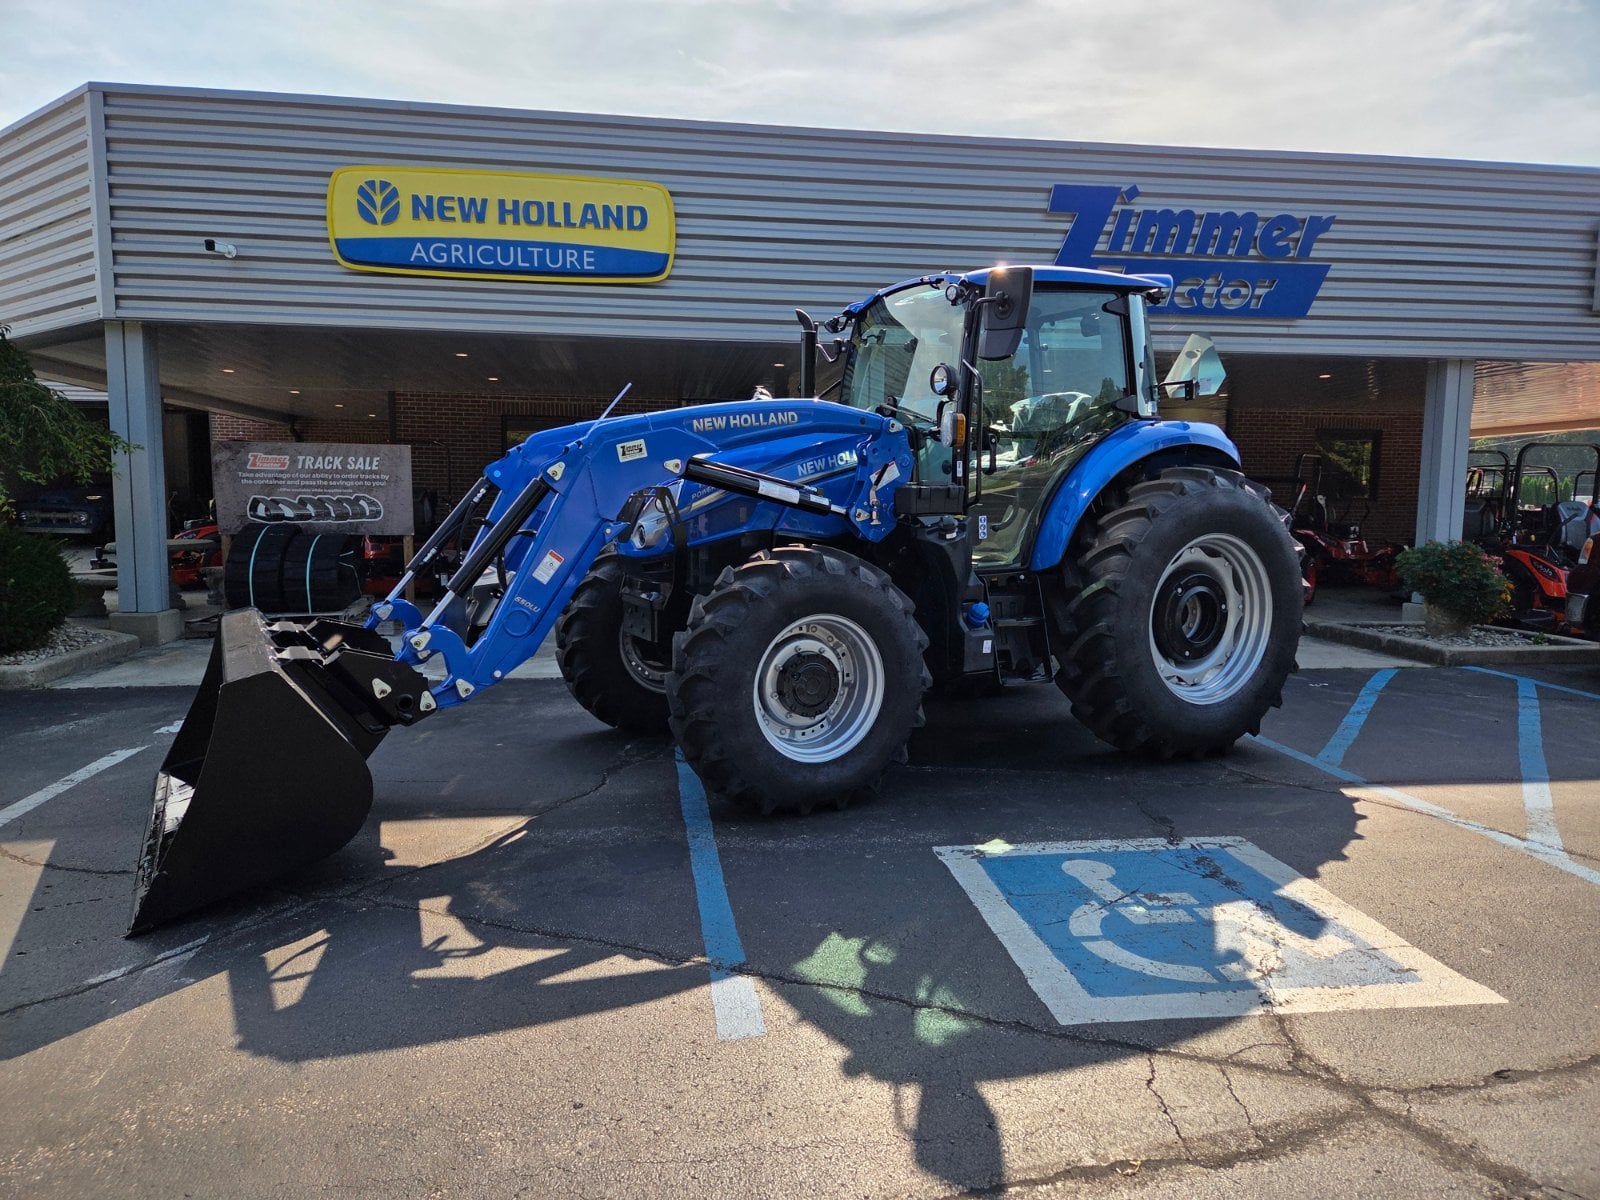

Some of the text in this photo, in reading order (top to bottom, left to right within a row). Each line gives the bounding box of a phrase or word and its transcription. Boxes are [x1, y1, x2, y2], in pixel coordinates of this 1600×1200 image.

[411, 194, 648, 231] NEW HOLLAND
[1047, 184, 1337, 260] Zimmer
[410, 242, 595, 269] AGRICULTURE
[692, 411, 798, 432] NEW HOLLAND
[297, 455, 343, 469] TRACK
[347, 456, 380, 470] SALE
[797, 449, 859, 476] NEW HOLL
[514, 596, 541, 613] 650LU
